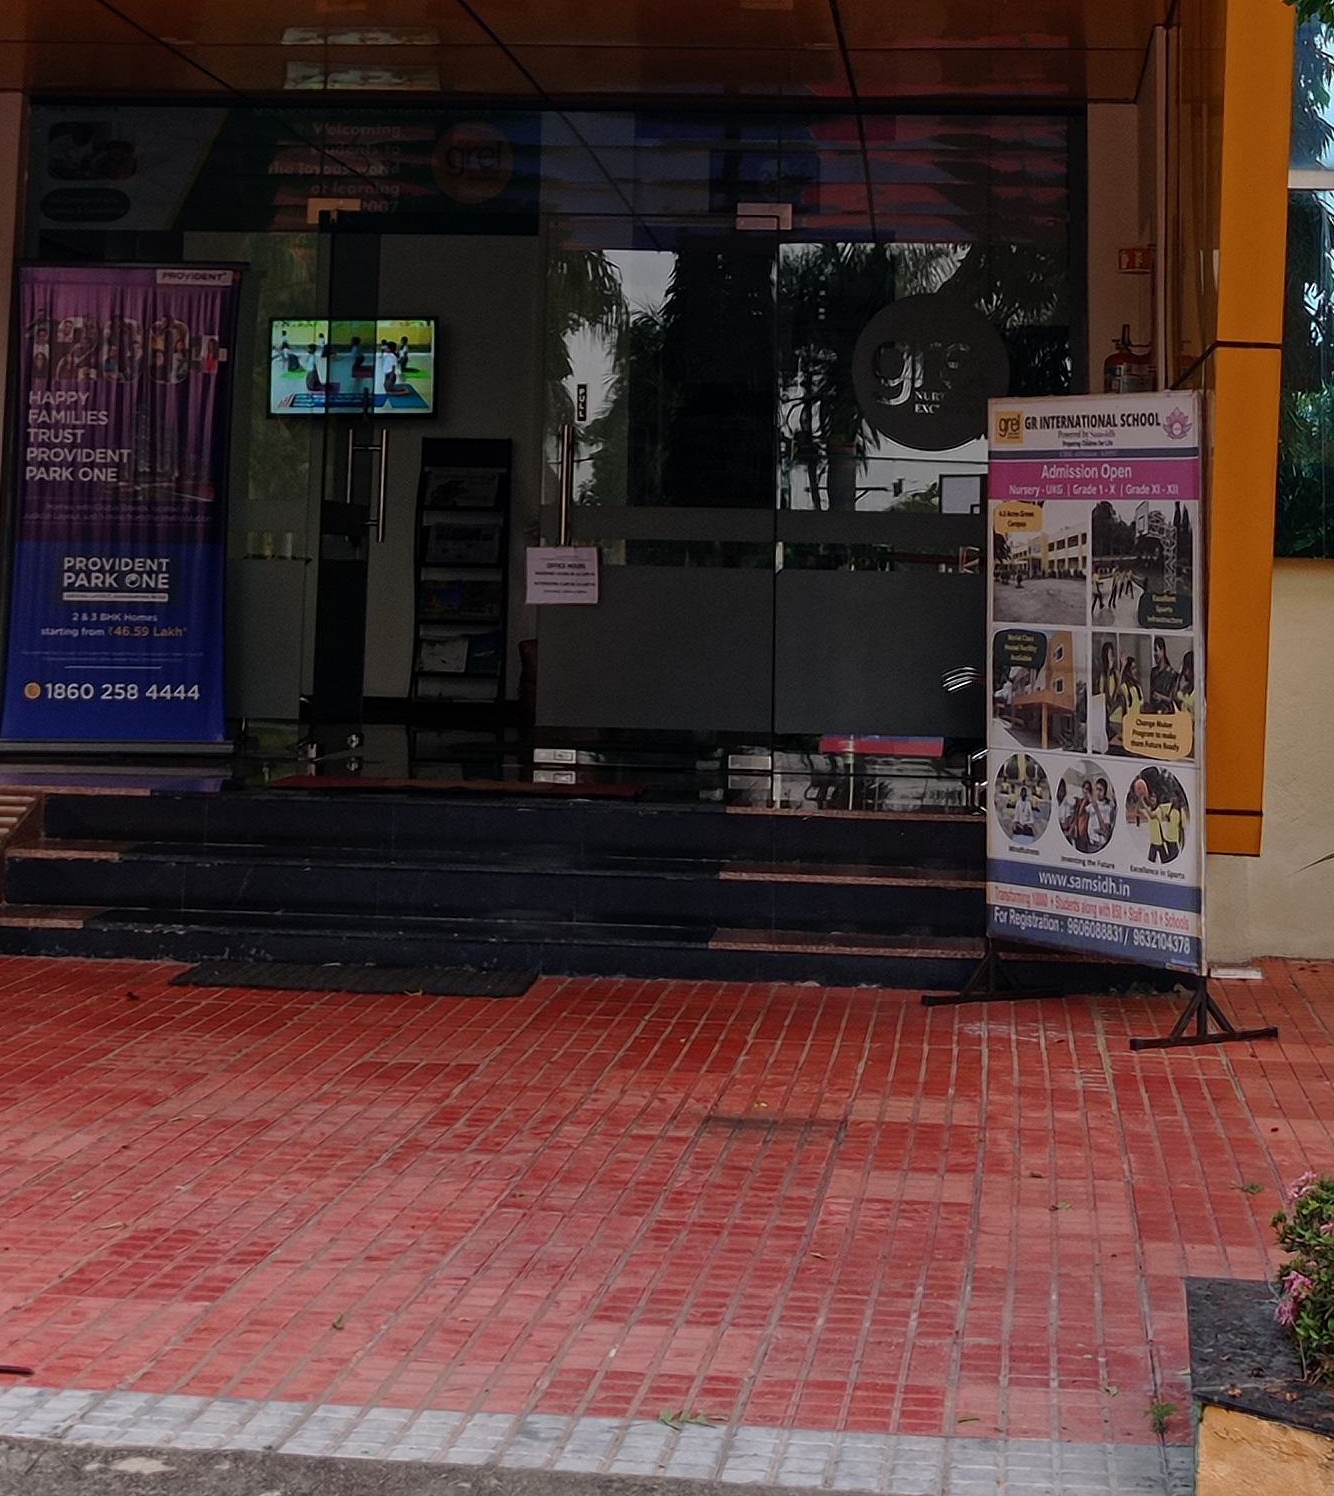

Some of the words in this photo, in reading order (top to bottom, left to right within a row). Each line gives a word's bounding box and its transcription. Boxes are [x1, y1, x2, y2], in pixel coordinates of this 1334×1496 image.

[162, 271, 222, 282] PROVIDENT
[28, 390, 90, 406] HAPPY
[578, 388, 586, 418] PULL
[28, 409, 109, 426] FAMILIES
[998, 414, 1020, 437] grei
[1024, 416, 1037, 430] GR
[1040, 414, 1118, 430] INTERNATIONAL
[1120, 412, 1160, 428] SCHOOL
[26, 428, 85, 443] TRUST
[25, 447, 131, 463] PROVIDENT
[25, 466, 74, 481] PARK
[78, 466, 119, 482] ONE
[1040, 464, 1098, 479] Admission
[1101, 462, 1132, 481] Open
[1009, 484, 1040, 497] Nursery
[1046, 484, 1063, 495] UKG
[1072, 484, 1097, 495] Grade
[1125, 484, 1150, 494] Grade
[1151, 484, 1160, 494] XI
[1167, 484, 1178, 494] XII
[63, 557, 170, 572] PROVIDENT
[62, 572, 119, 588] PARK
[125, 572, 170, 589] ONE
[99, 613, 122, 622] BHK
[124, 613, 158, 622] Homes
[41, 627, 79, 638] starting
[80, 627, 105, 636] from
[44, 683, 95, 700] 1860
[100, 683, 139, 700] 258
[145, 684, 200, 701] 4444
[1130, 864, 1159, 876] Excellence
[1167, 869, 1185, 880] Sports
[1038, 870, 1131, 898] www.samsidh.in
[1055, 895, 1080, 913] Students
[1164, 912, 1189, 931] Schools
[994, 906, 1007, 924] For
[1133, 929, 1191, 955] 9632104378
